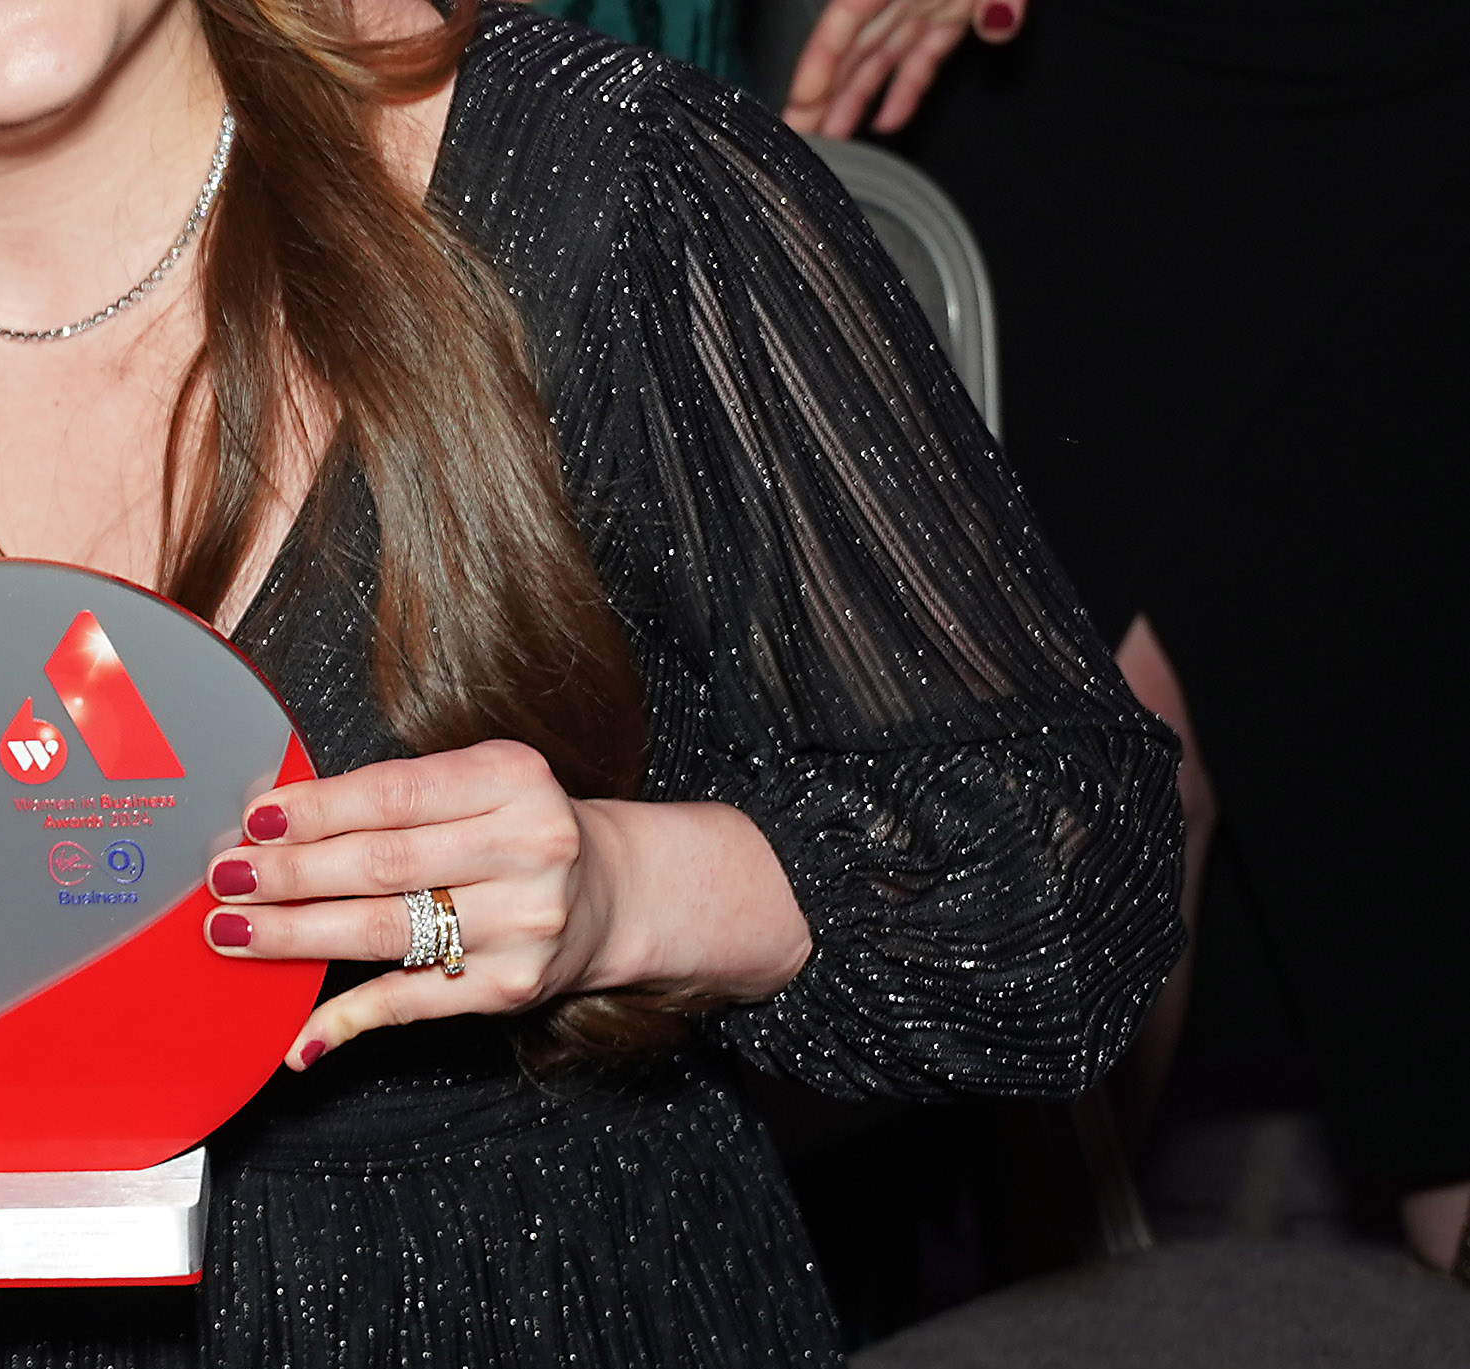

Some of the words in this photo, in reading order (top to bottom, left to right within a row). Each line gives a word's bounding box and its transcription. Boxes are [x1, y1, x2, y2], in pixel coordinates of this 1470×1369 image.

[14, 797, 75, 811] Women
[80, 795, 96, 809] in
[100, 793, 176, 809] Business
[43, 813, 104, 829] Awards
[109, 810, 153, 827] 2024
[59, 890, 138, 905] Business
